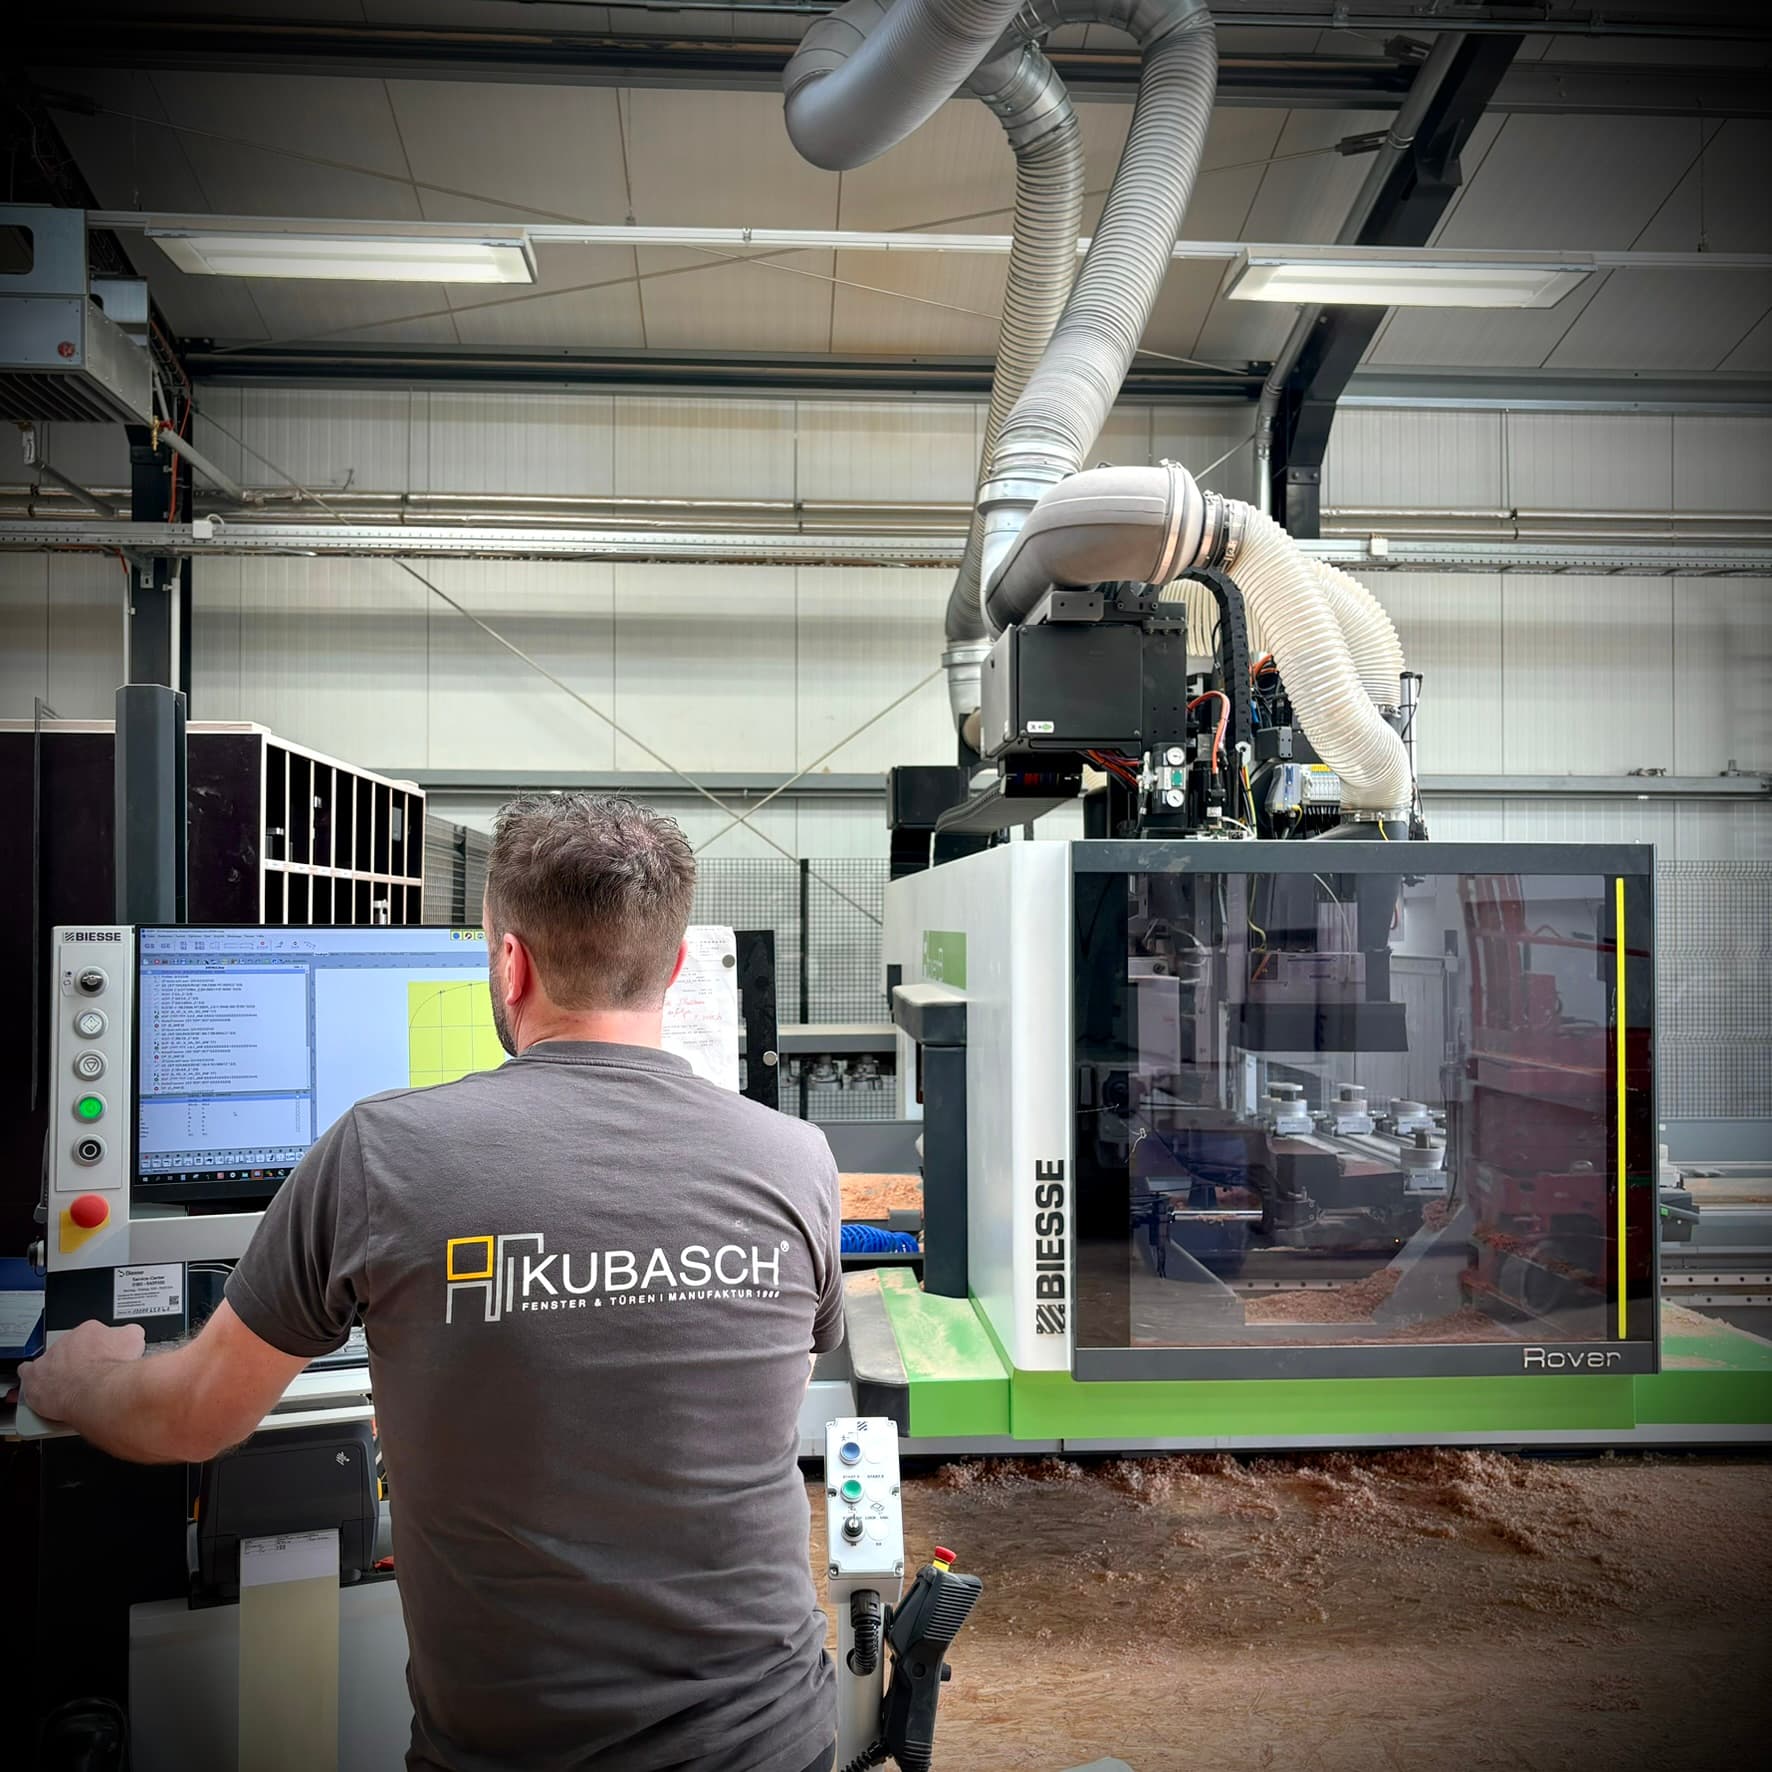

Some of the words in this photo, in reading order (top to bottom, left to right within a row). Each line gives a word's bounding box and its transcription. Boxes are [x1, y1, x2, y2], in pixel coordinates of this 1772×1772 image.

[76, 932, 121, 941] BIESSE
[1035, 1159, 1065, 1299] BIESSE
[522, 1299, 586, 1311] FENSTER
[594, 1298, 602, 1307] &
[668, 1288, 753, 1301] MANUFAKTUR
[1523, 1347, 1622, 1368] Rover
